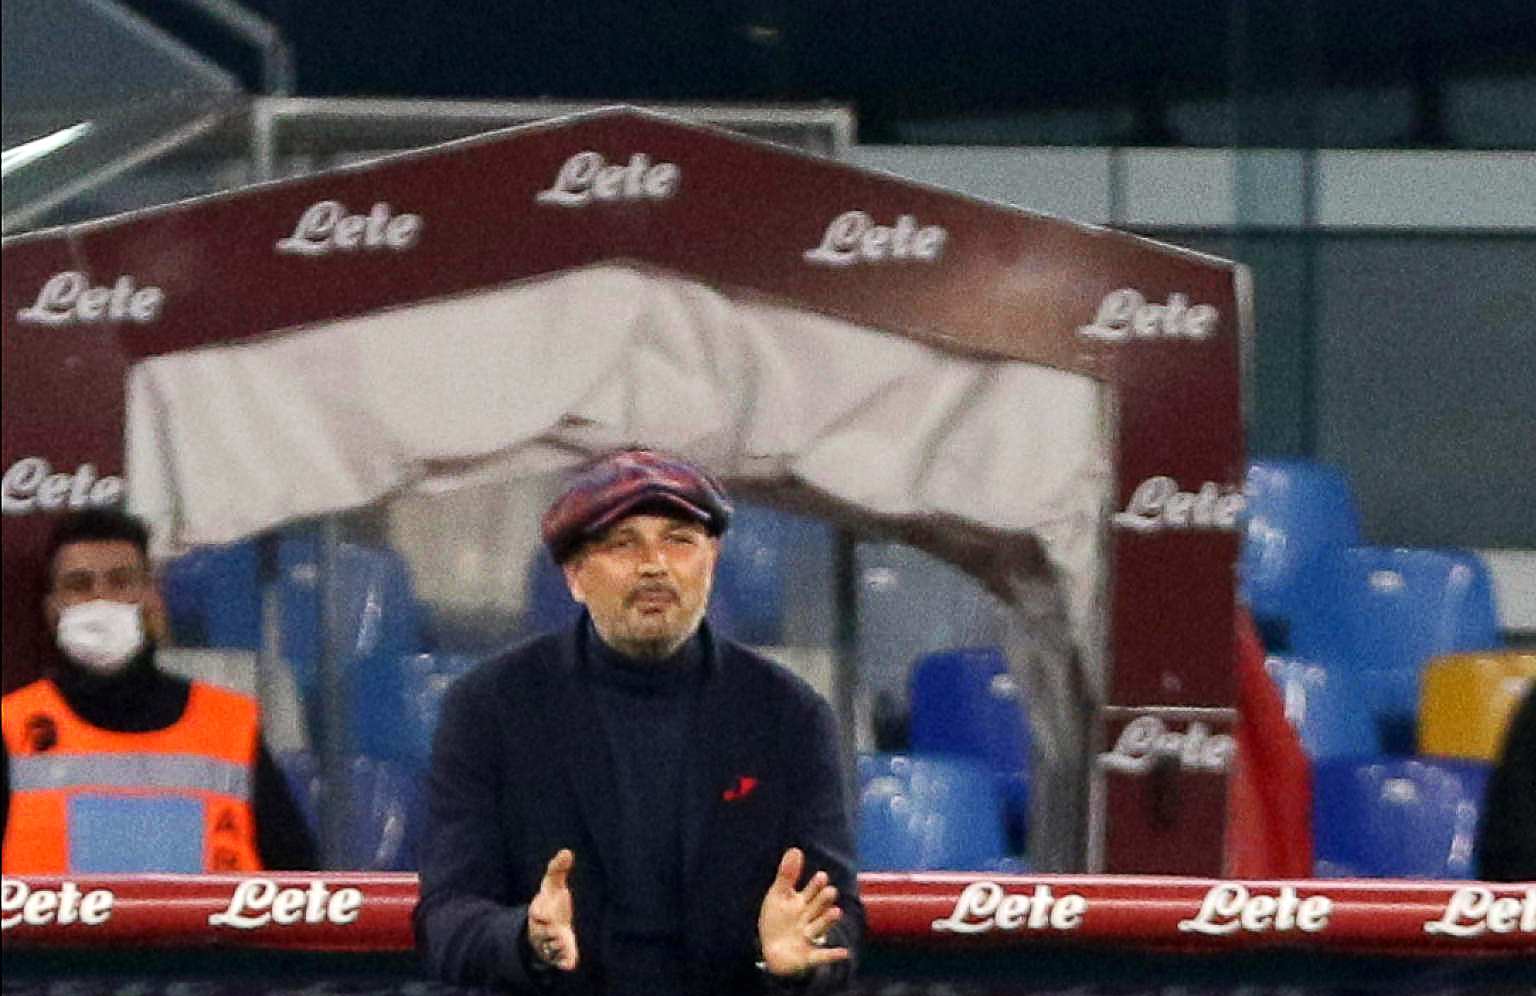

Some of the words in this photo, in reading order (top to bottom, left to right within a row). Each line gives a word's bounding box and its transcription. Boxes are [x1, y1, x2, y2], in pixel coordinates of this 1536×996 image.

[535, 151, 681, 206] Lete
[276, 200, 424, 255] Lete
[803, 210, 948, 267] Lete
[16, 271, 164, 325] Lete
[1075, 288, 1221, 341] Lete
[1112, 476, 1245, 533] Lete
[207, 879, 364, 929] Lete
[932, 881, 1087, 935] Lete
[1177, 883, 1333, 936] Lete
